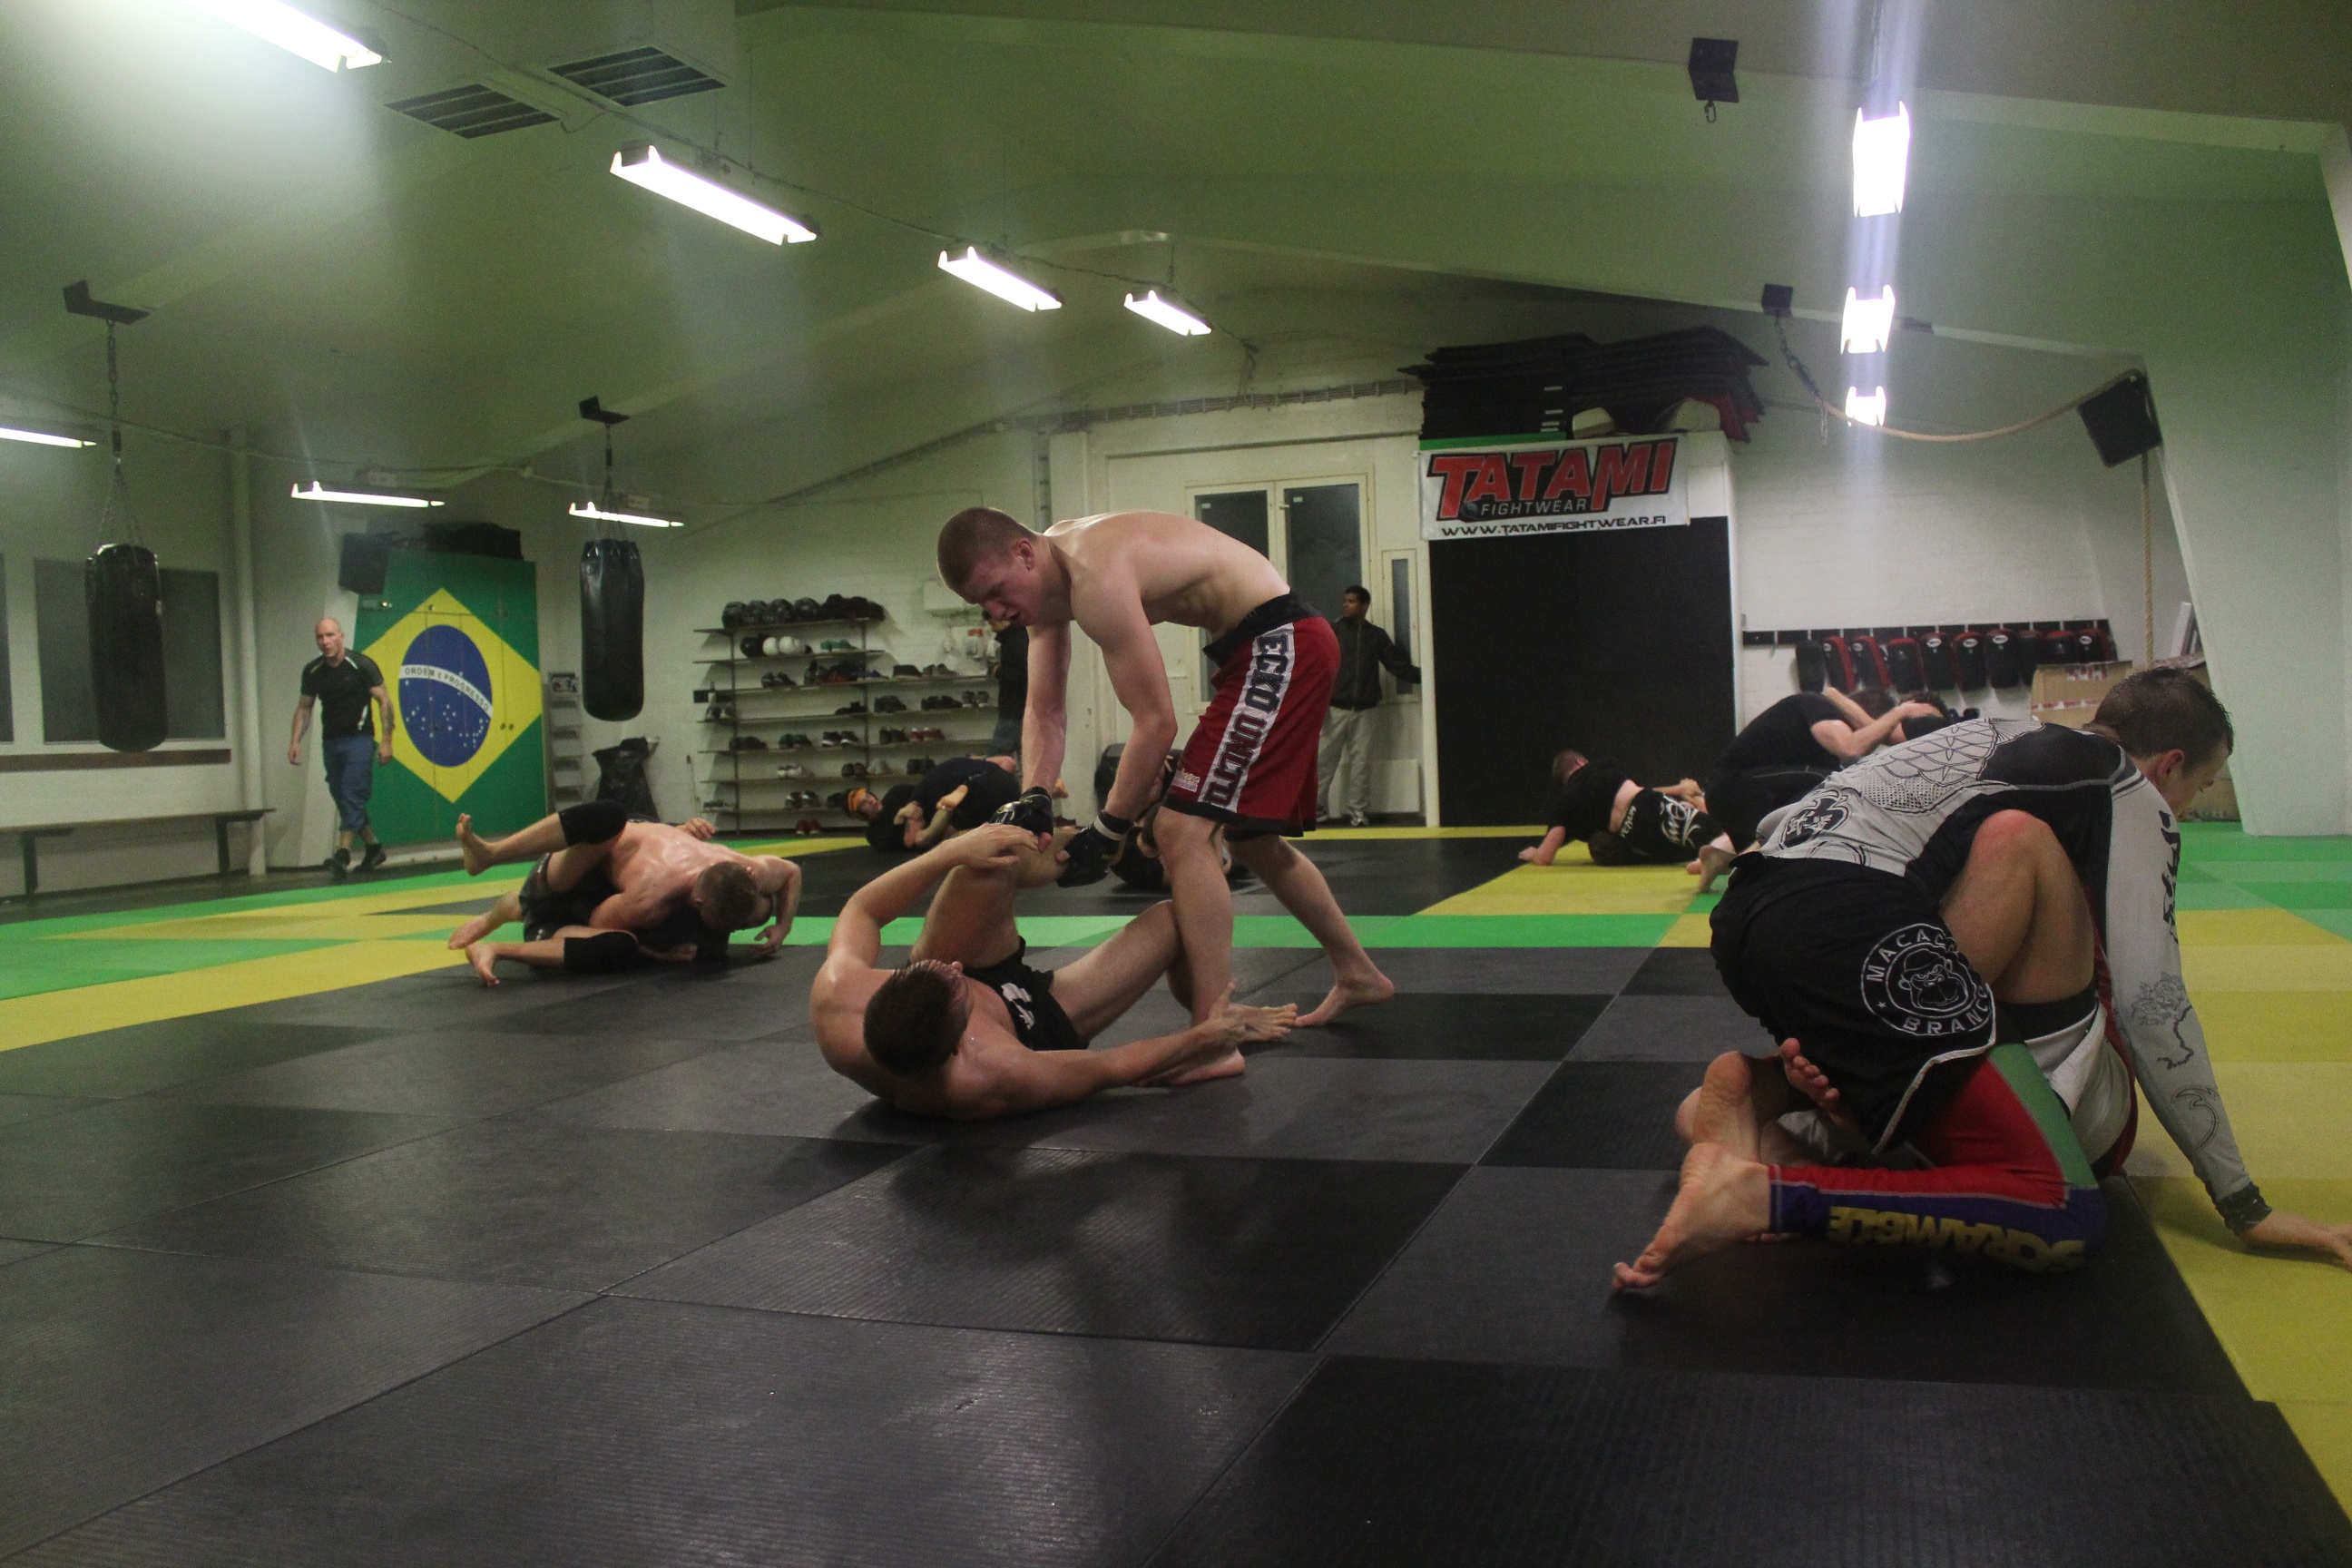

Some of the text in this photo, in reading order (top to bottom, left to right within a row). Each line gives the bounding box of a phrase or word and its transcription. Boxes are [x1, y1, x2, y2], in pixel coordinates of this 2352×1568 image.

[1428, 439, 1677, 520] TATAMI
[1442, 515, 1666, 536] WWW.TATAMIFIGHTWEAR.FI
[1480, 500, 1587, 516] FIGHTWEAR
[405, 667, 435, 677] ORDEM
[444, 674, 489, 710] PROGRESSO
[1203, 633, 1289, 808] ECKO UNLTD
